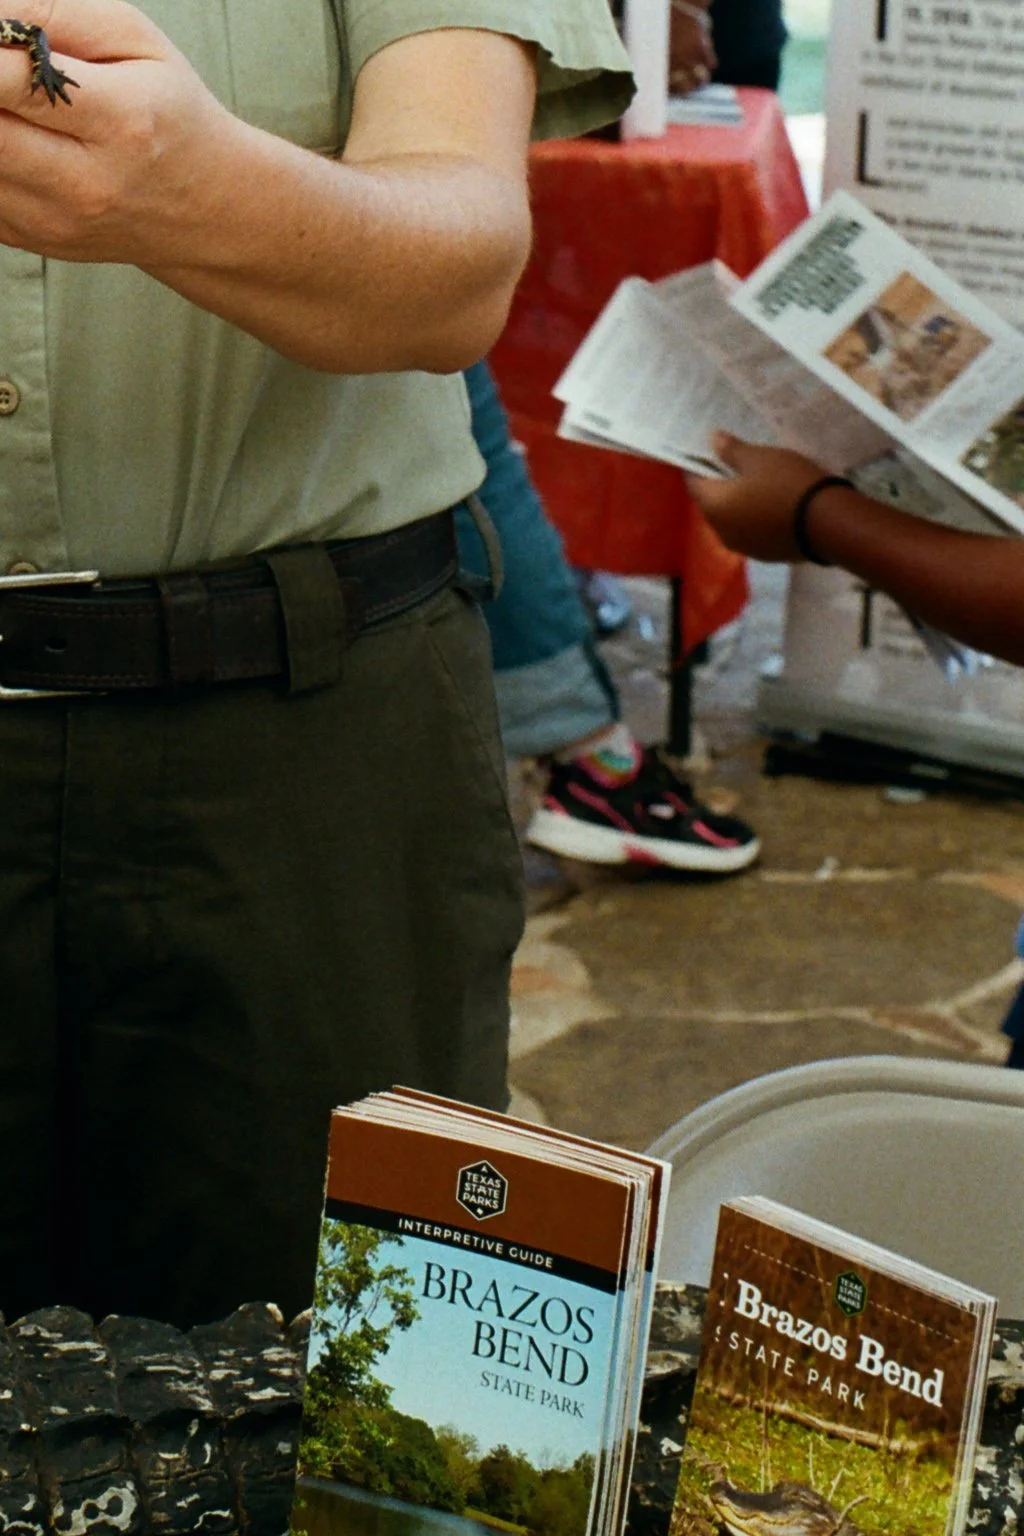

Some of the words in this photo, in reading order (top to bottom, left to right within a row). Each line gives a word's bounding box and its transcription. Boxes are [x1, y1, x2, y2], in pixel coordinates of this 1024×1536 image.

[462, 1192, 499, 1210] PARKS
[464, 1182, 500, 1199] STATE
[466, 1171, 502, 1189] TEXAS
[398, 1218, 504, 1255] INTERPRETIVE
[509, 1246, 554, 1269] GUIDE
[422, 1261, 596, 1345] BRAZOS
[837, 1294, 861, 1310] PARKS
[840, 1276, 864, 1293] TEXAS
[471, 1320, 590, 1387] BEND
[734, 1278, 847, 1361] Brazos
[855, 1333, 945, 1408] Bend
[480, 1369, 536, 1403] STATE
[540, 1389, 586, 1419] PARK
[729, 1331, 795, 1377] STATE
[806, 1368, 866, 1411] PARK
